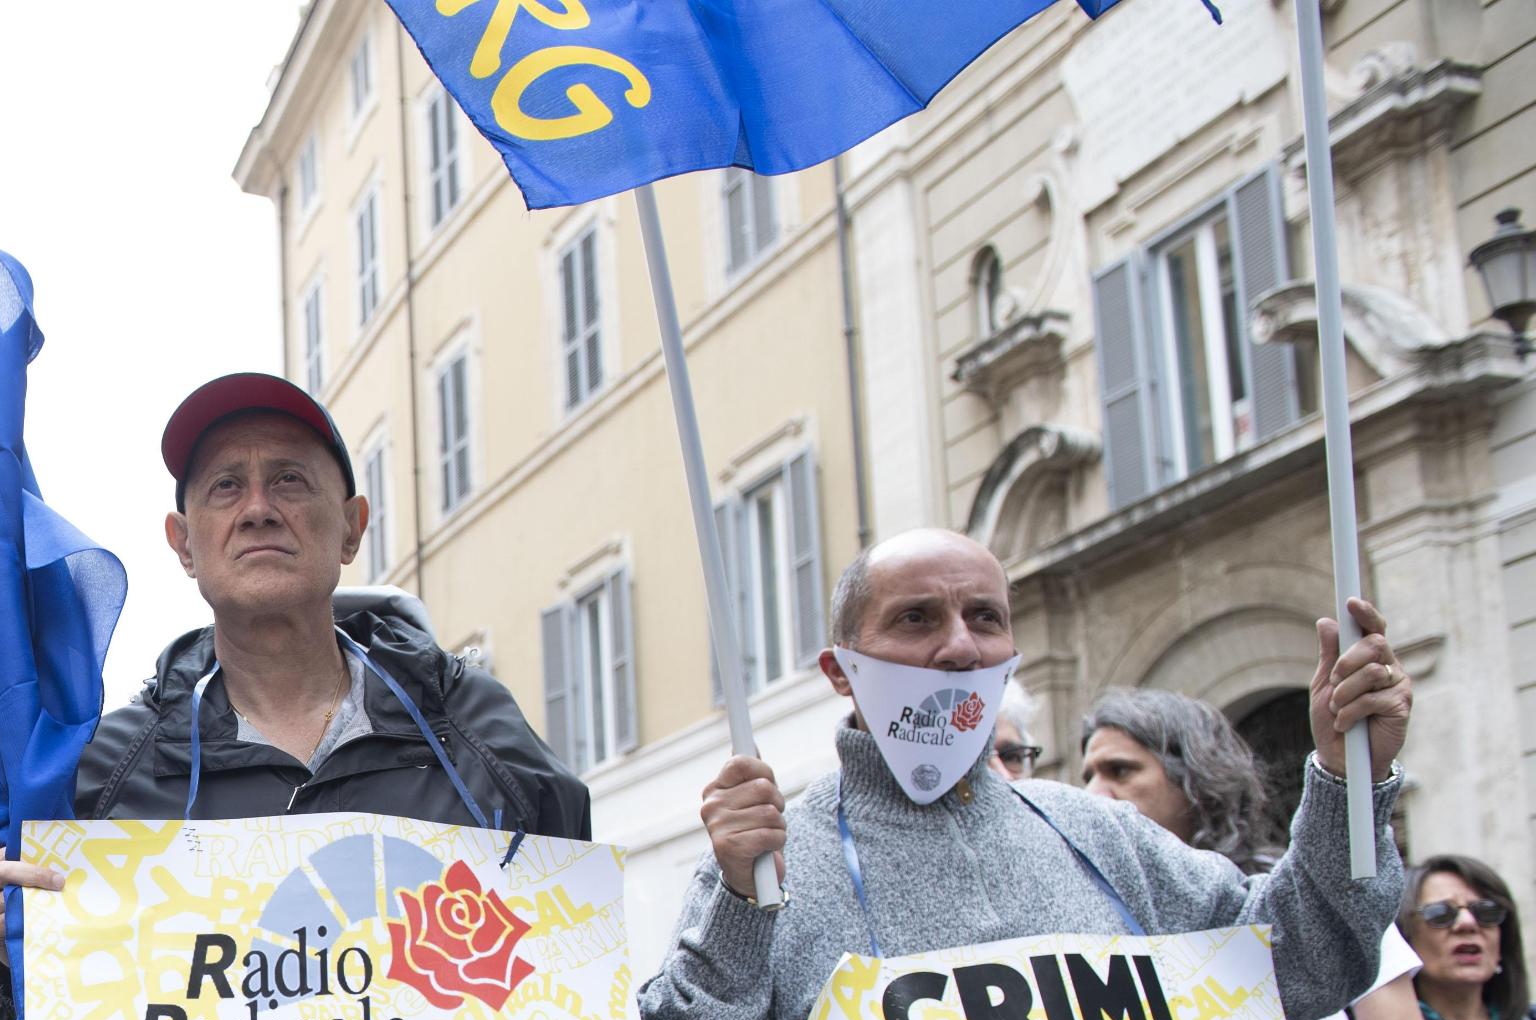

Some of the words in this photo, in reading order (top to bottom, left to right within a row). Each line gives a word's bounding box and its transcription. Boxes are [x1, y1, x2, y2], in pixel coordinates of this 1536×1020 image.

[900, 706, 947, 729] Radio
[887, 721, 954, 746] Radicale
[187, 925, 373, 999] Radio
